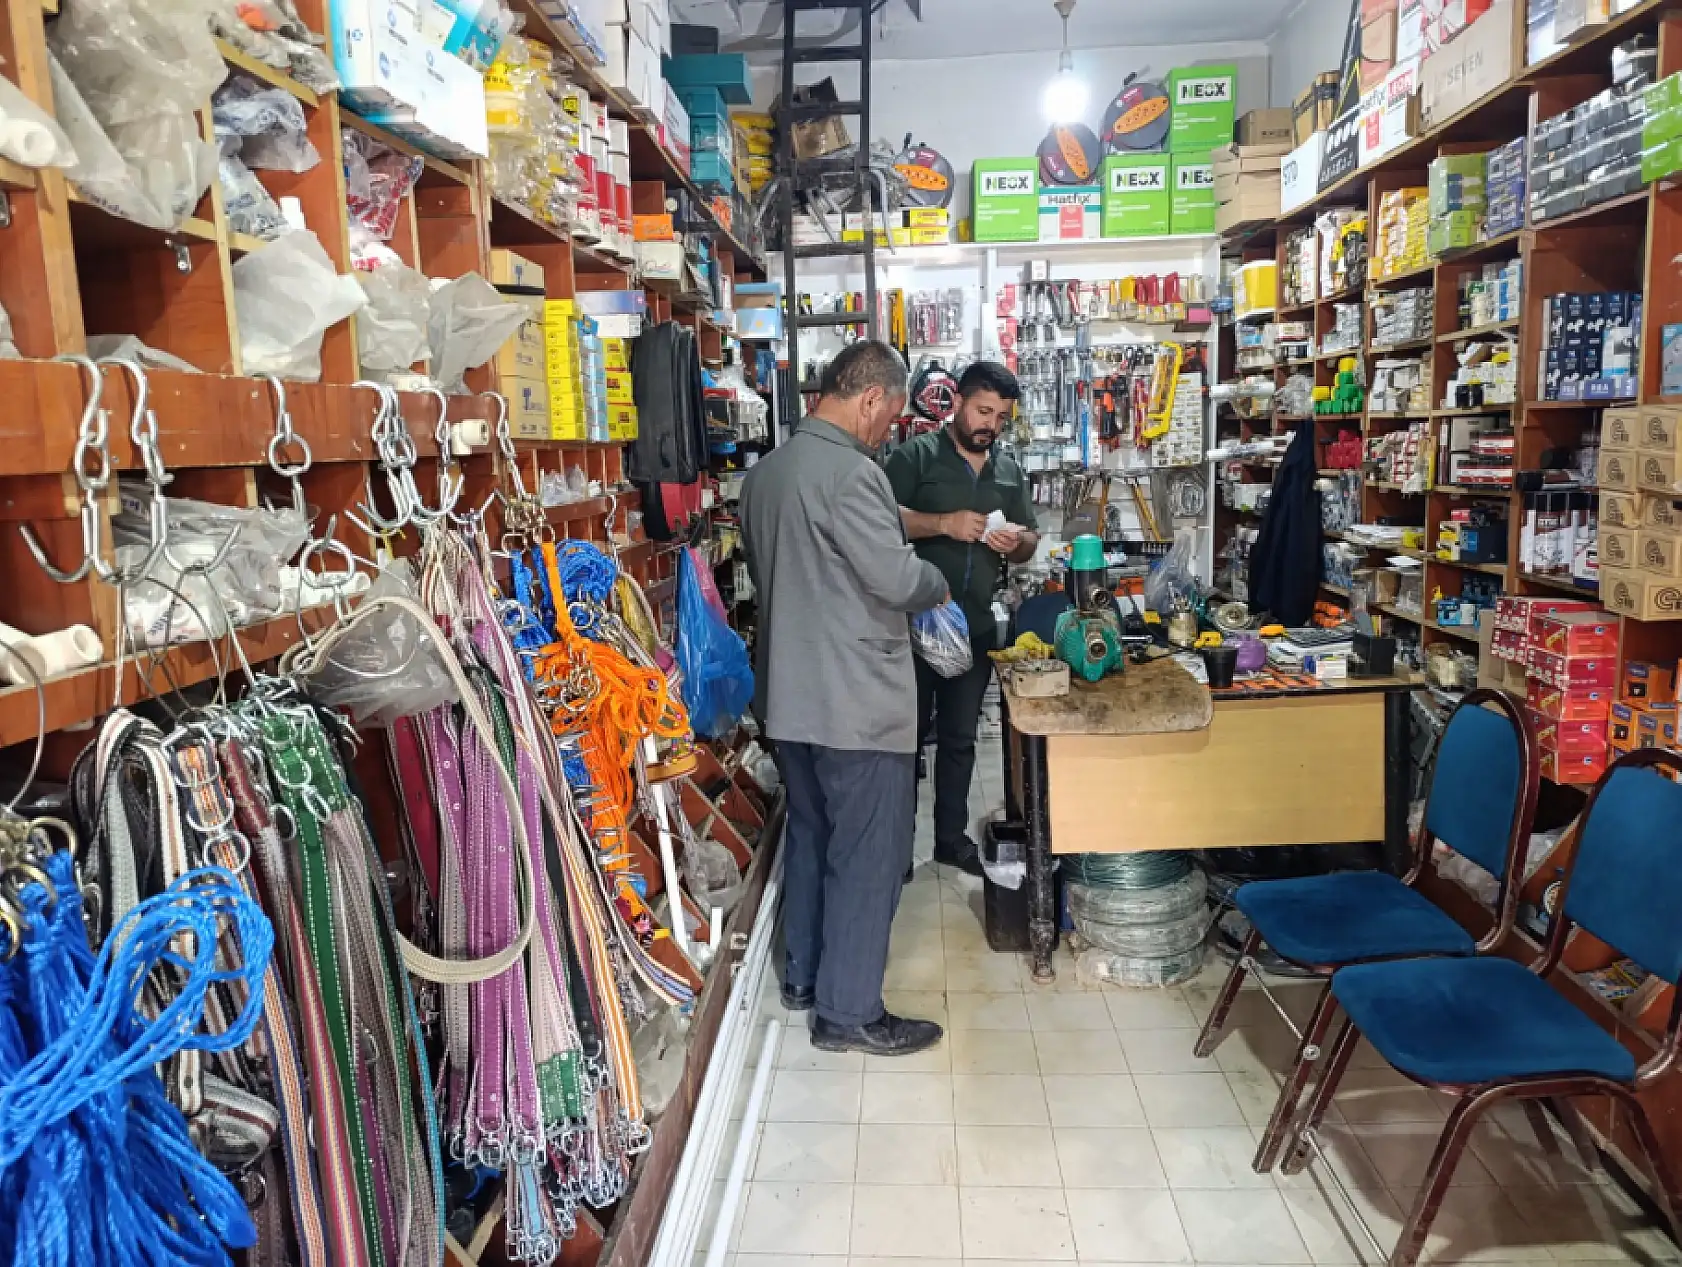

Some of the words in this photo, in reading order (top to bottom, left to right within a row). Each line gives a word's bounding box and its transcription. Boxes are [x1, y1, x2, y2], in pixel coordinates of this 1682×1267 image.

[1181, 82, 1226, 98] NEOX
[986, 176, 1029, 190] NEOX
[1116, 171, 1160, 187] NEOX
[1181, 169, 1214, 185] NEO
